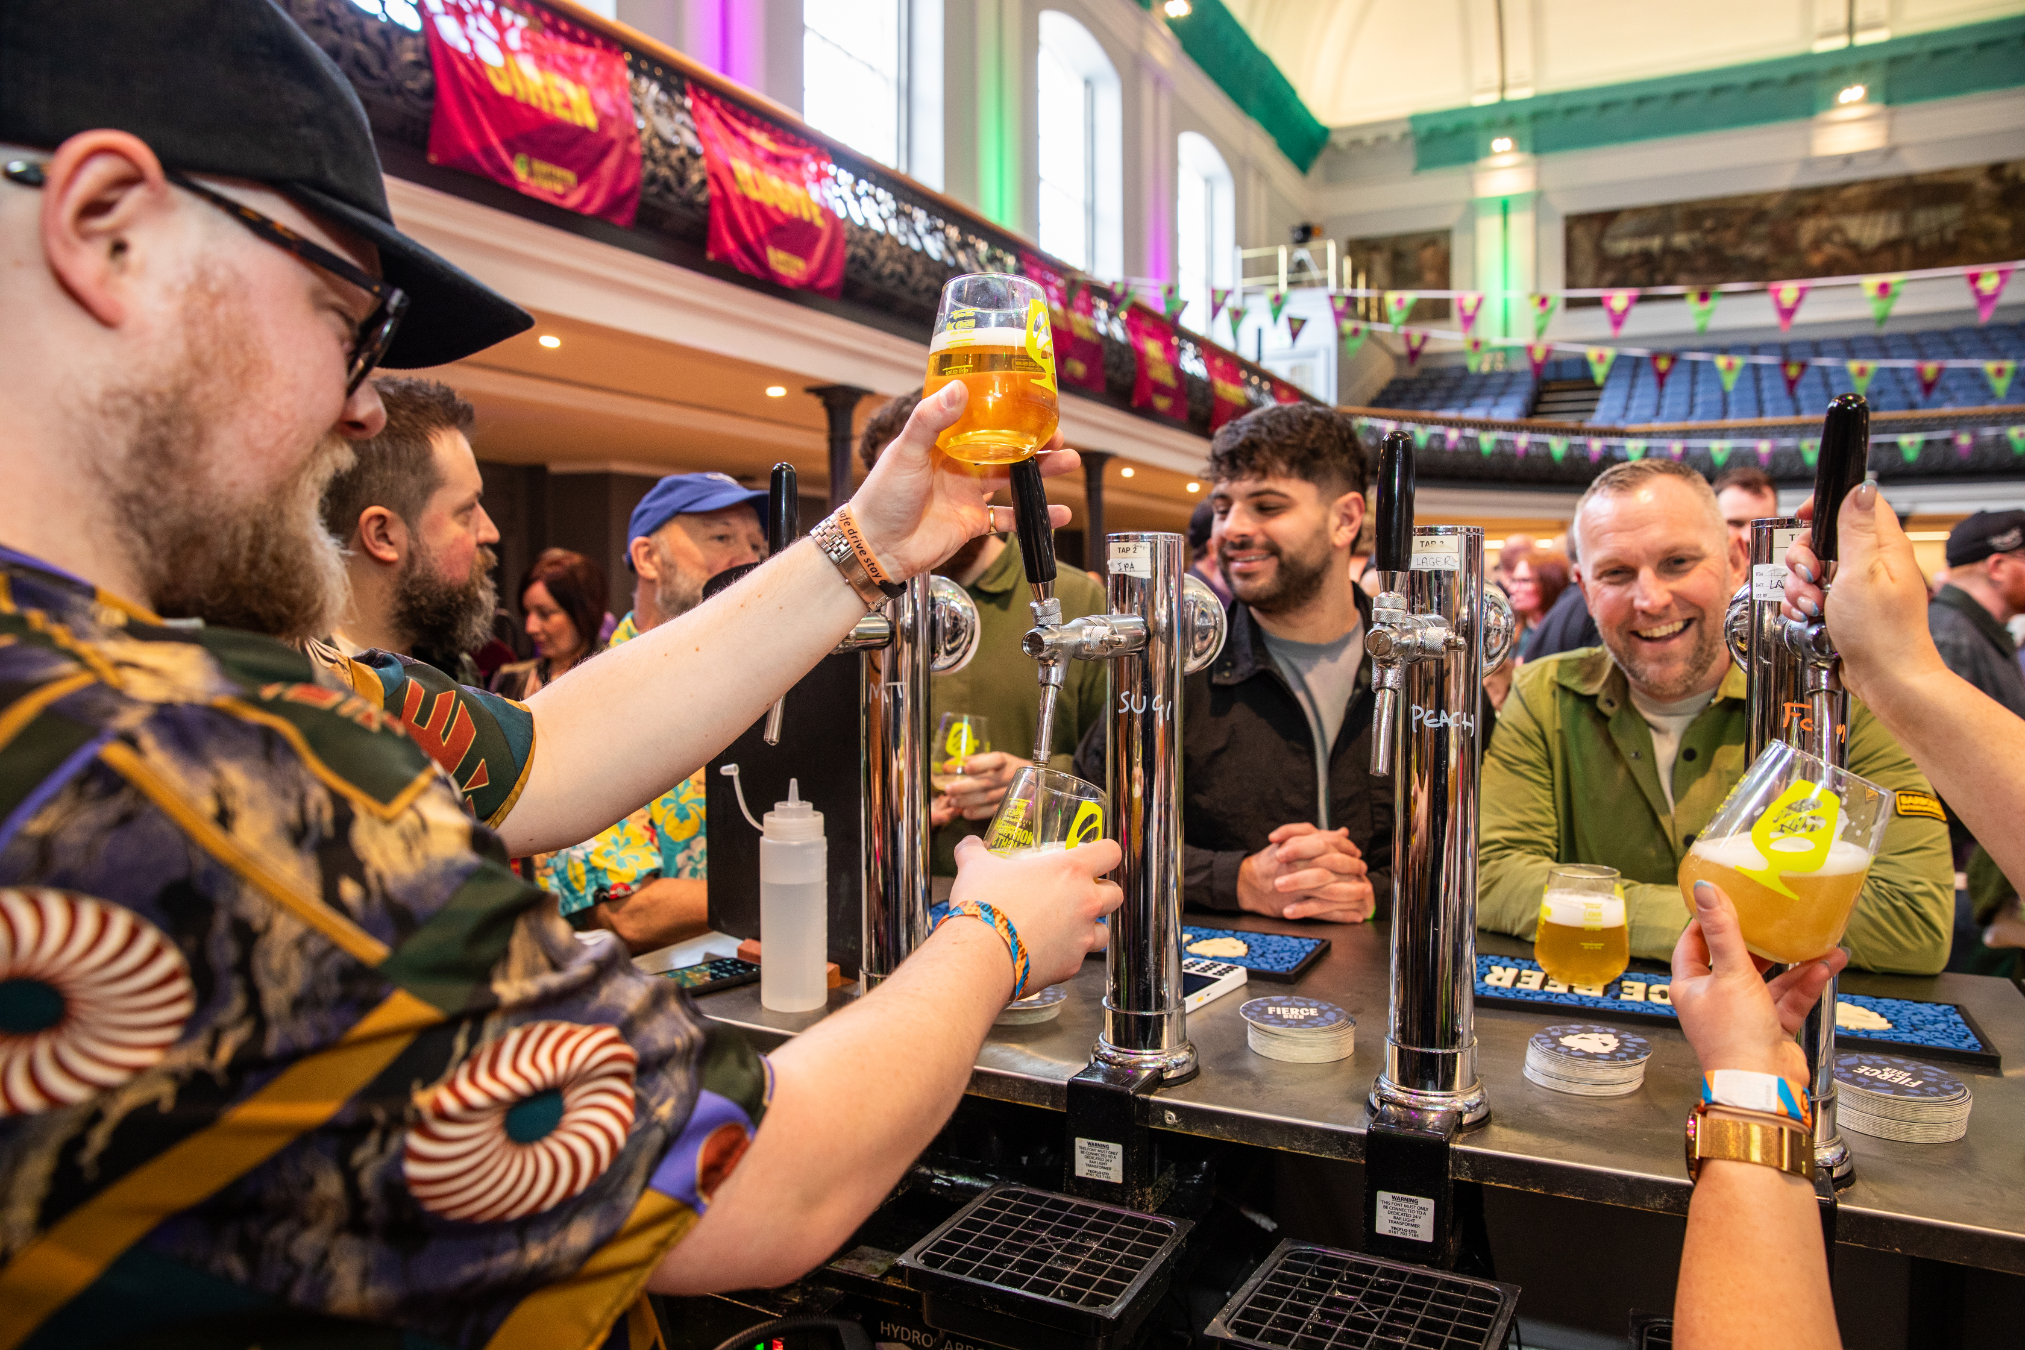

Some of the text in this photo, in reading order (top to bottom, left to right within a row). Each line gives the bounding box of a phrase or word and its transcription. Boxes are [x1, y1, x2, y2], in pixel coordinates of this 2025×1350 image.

[838, 509, 851, 527] safe
[847, 528, 867, 556] drive
[863, 558, 883, 579] stay
[1420, 540, 1437, 548] TAP
[1117, 546, 1138, 554] TAP 2
[1416, 555, 1455, 567] LAGER
[1117, 561, 1135, 572] IPA
[1118, 690, 1172, 727] SUGI
[1411, 703, 1475, 738] PEACH
[1267, 1006, 1319, 1016] FIERCE
[1852, 1065, 1924, 1088] FIERCE
[1882, 1067, 1912, 1078] BEER
[1087, 1141, 1110, 1149] WARNING
[1391, 1195, 1419, 1204] WARNING
[1387, 1210, 1412, 1218] DEDICATED
[1389, 1206, 1416, 1214] CONNECTED
[1388, 1219, 1421, 1228] TRANSFORMER
